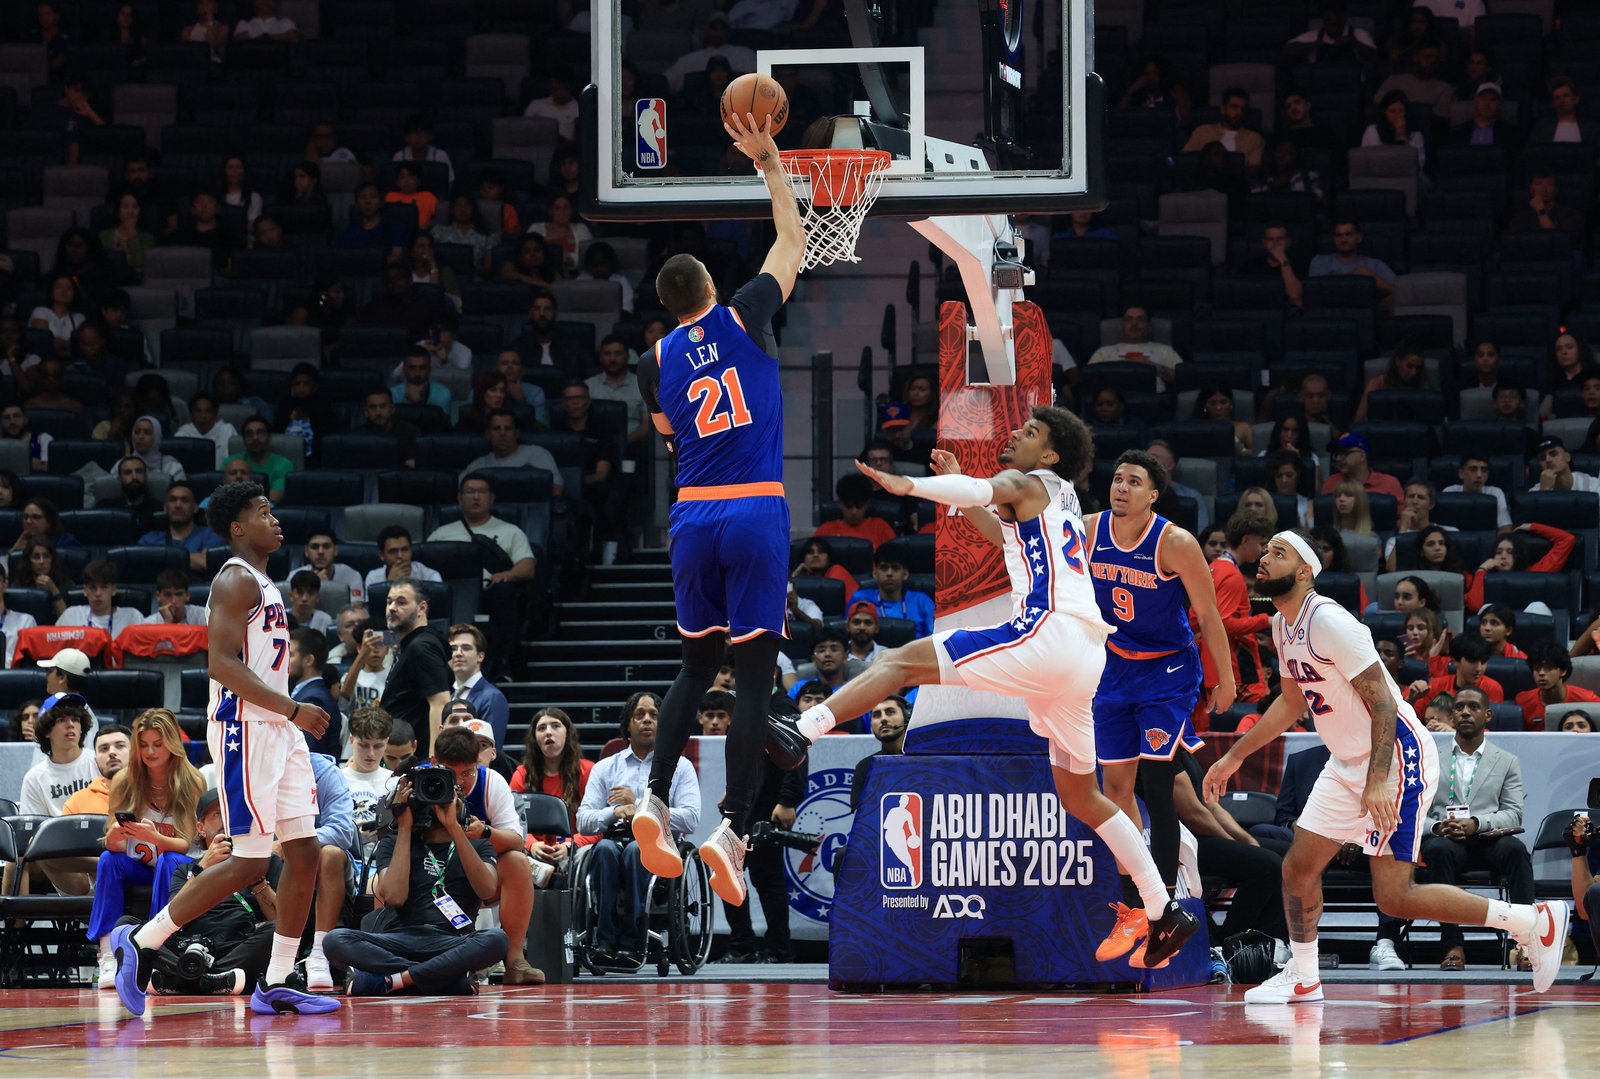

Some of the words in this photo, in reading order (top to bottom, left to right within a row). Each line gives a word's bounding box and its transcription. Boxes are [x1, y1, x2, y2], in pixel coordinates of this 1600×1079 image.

[640, 152, 656, 164] NBA
[685, 342, 719, 371] LEN
[686, 366, 753, 439] 21
[1090, 562, 1120, 582] NEW
[1119, 566, 1158, 589] YORK
[1111, 586, 1136, 623] 9
[654, 625, 666, 640] G
[624, 666, 634, 681] F
[591, 707, 601, 723] E
[930, 793, 983, 839] ABU
[988, 793, 1067, 838] DHABI
[887, 867, 907, 883] NBA
[931, 840, 1017, 887] GAMES
[1023, 839, 1094, 887] 2025
[882, 894, 919, 908] Presented
[920, 894, 929, 910] by
[932, 894, 986, 920] ADQ
